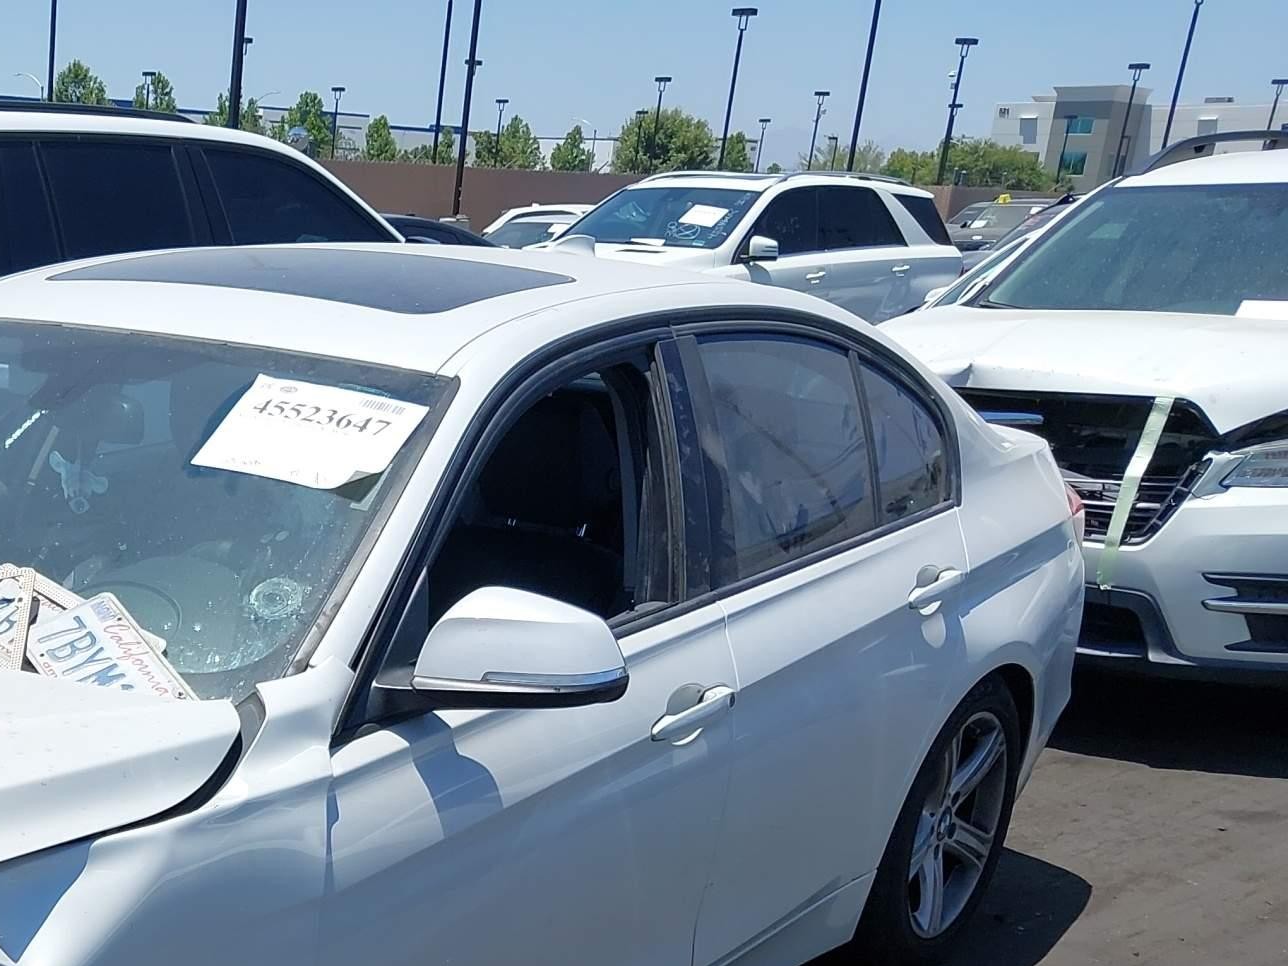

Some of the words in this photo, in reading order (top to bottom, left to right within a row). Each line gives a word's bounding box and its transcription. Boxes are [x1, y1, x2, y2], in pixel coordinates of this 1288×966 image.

[253, 398, 393, 436] 45523647
[38, 615, 135, 690] 7BYM
[103, 623, 169, 696] California
